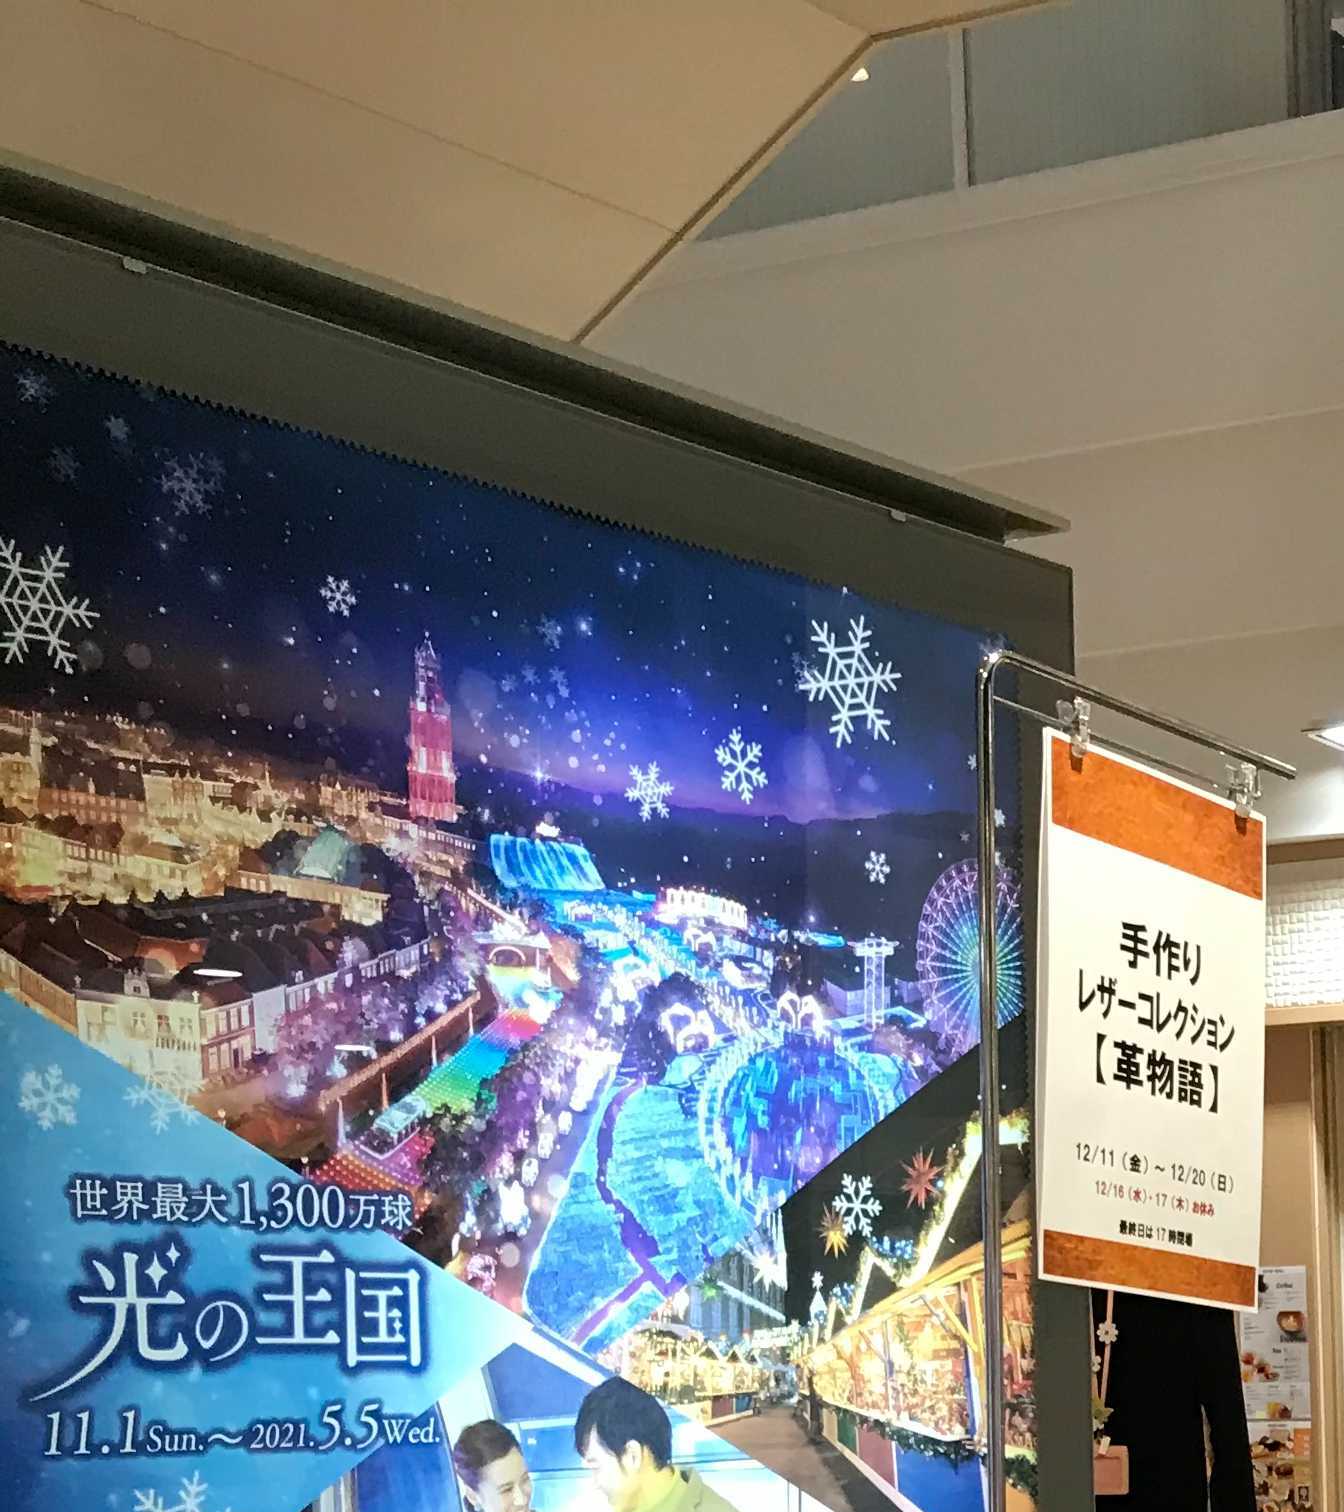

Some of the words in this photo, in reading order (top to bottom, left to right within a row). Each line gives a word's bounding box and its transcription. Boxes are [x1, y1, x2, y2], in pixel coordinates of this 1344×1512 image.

[1120, 921, 1201, 986] 手作り
[1079, 968, 1235, 1053] レザーコレクション
[1097, 1032, 1218, 1114] 【革物語】
[70, 1180, 414, 1230] 世界最大1,300万球
[29, 1243, 422, 1402] 光の王国
